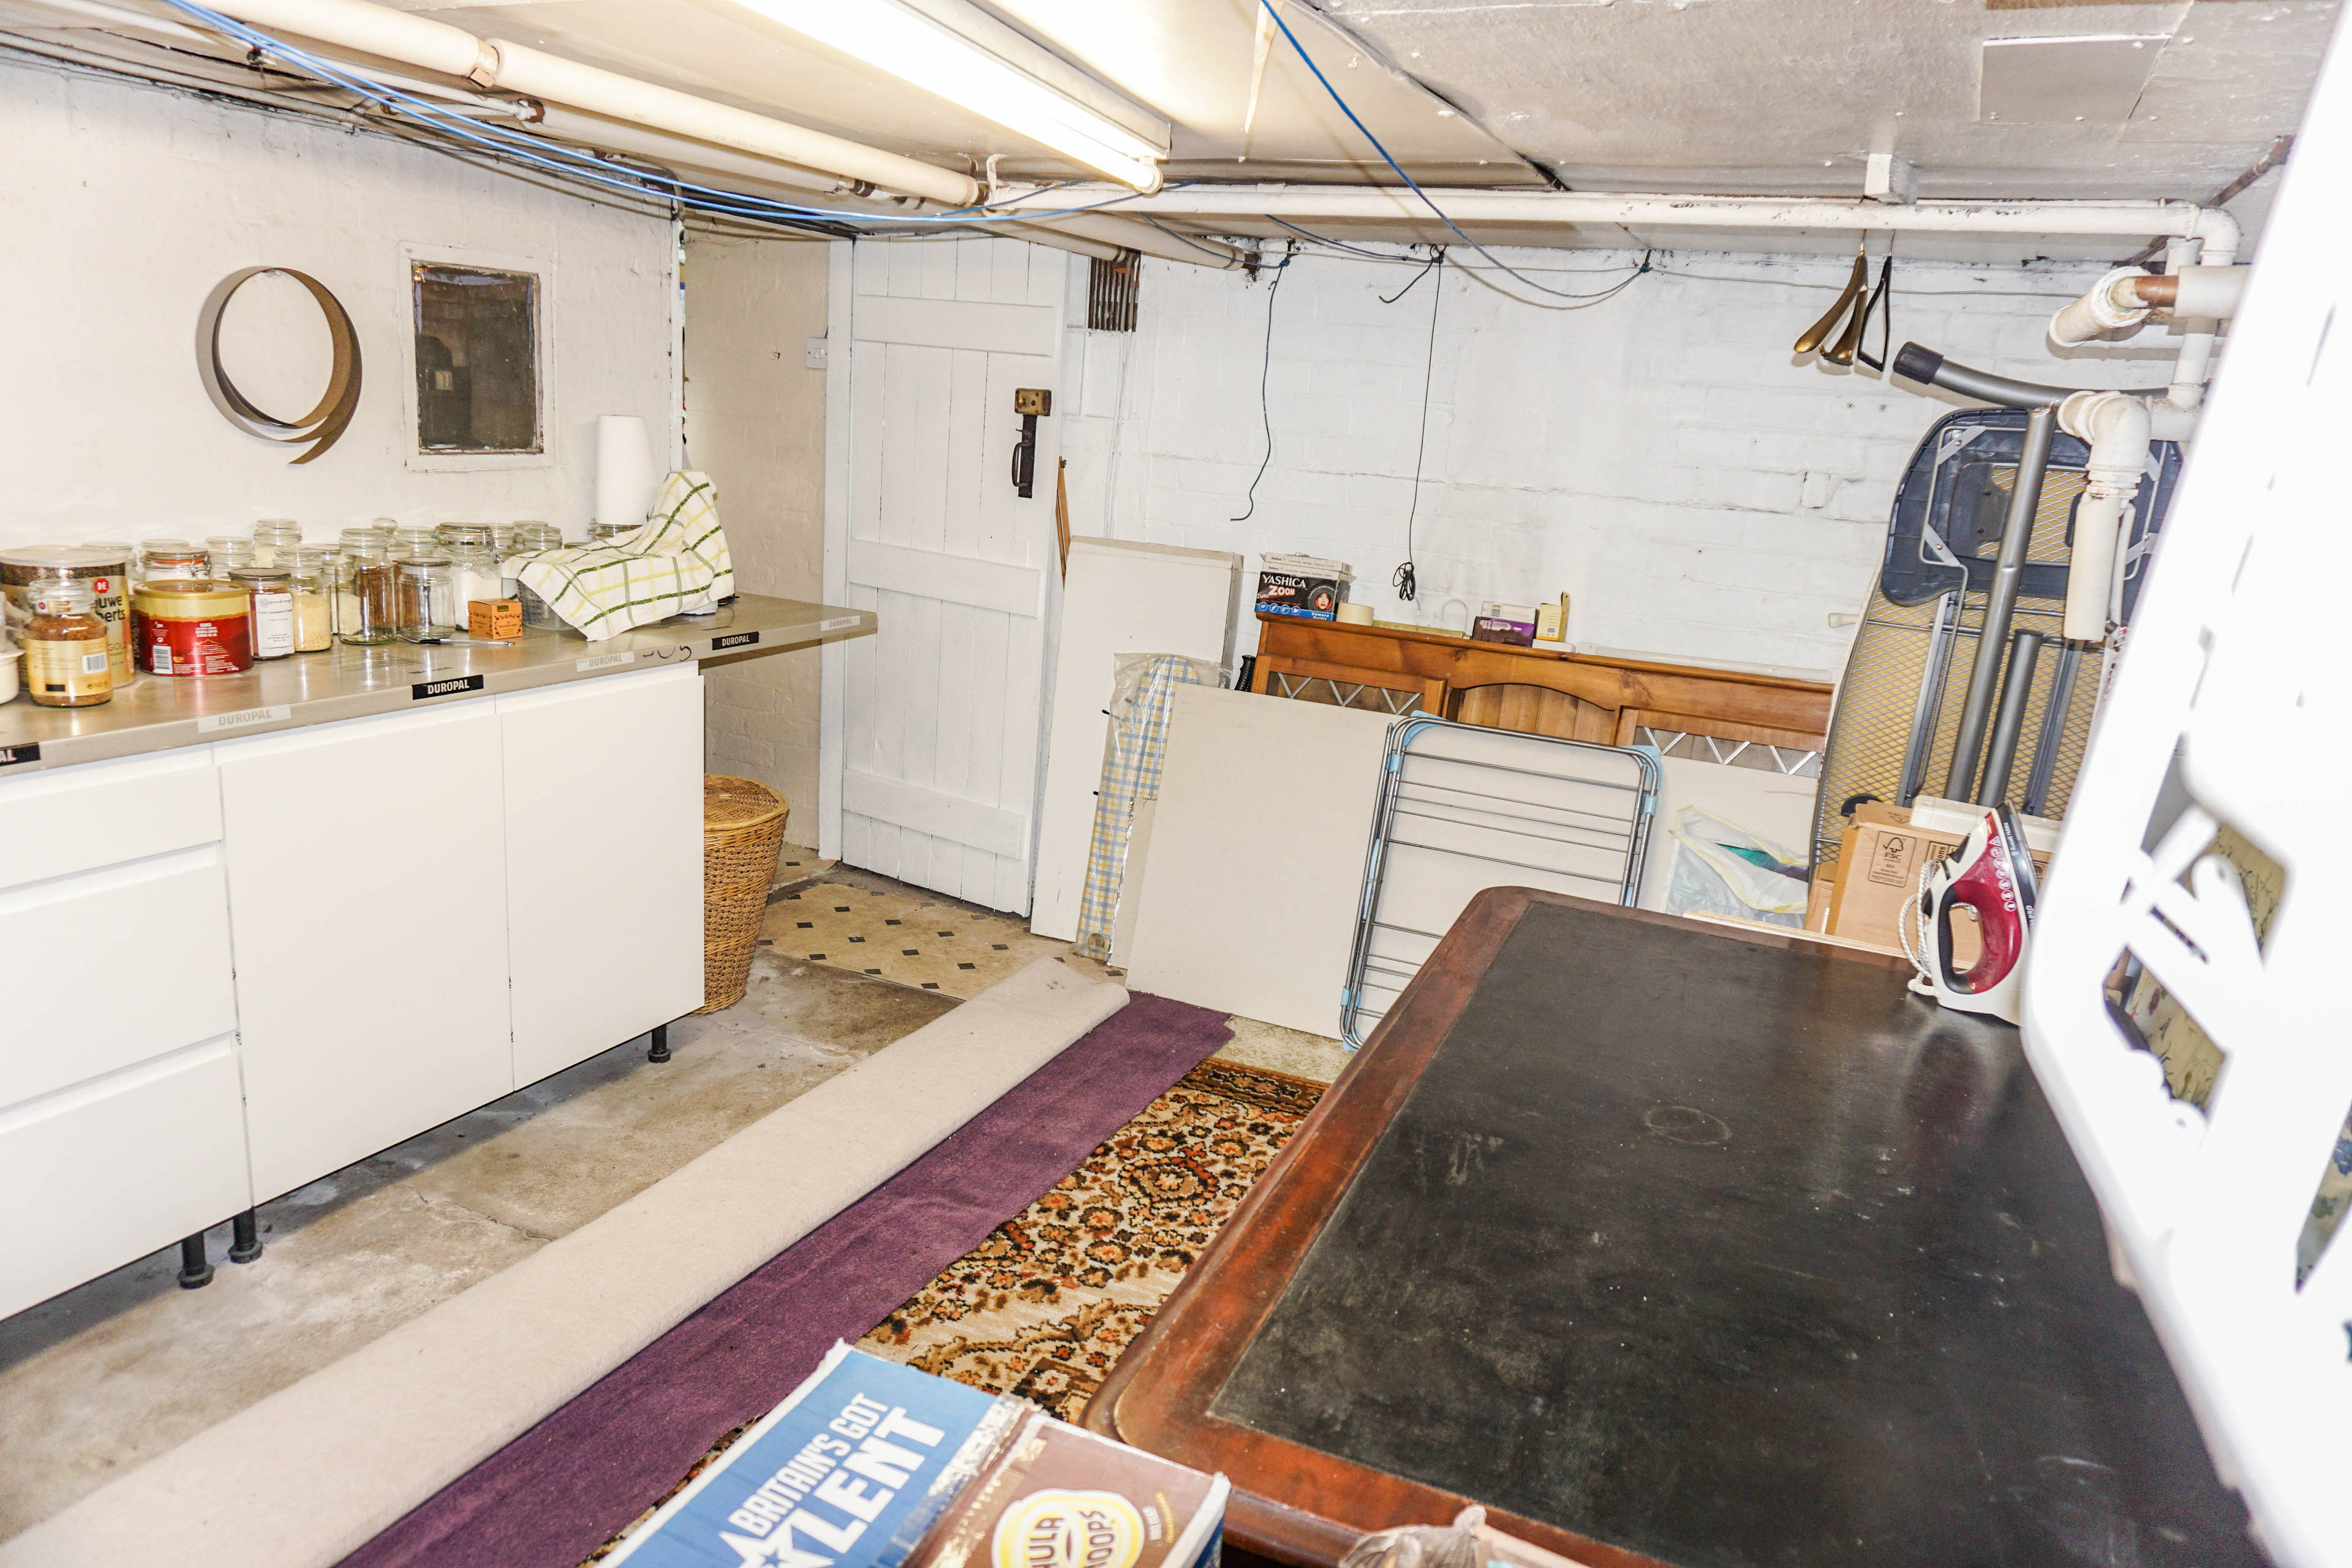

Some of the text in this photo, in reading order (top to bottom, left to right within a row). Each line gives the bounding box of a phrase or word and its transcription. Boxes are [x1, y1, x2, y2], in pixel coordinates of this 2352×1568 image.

[1262, 574, 1306, 588] YASHICA
[1268, 585, 1295, 596] ZOOM
[722, 635, 750, 646] DUROPAL
[589, 654, 622, 666] DUROPAL
[428, 679, 470, 695] DUROPAL
[218, 709, 272, 726] DUROPAL
[728, 1392, 888, 1537] BRITAIN'S GOT
